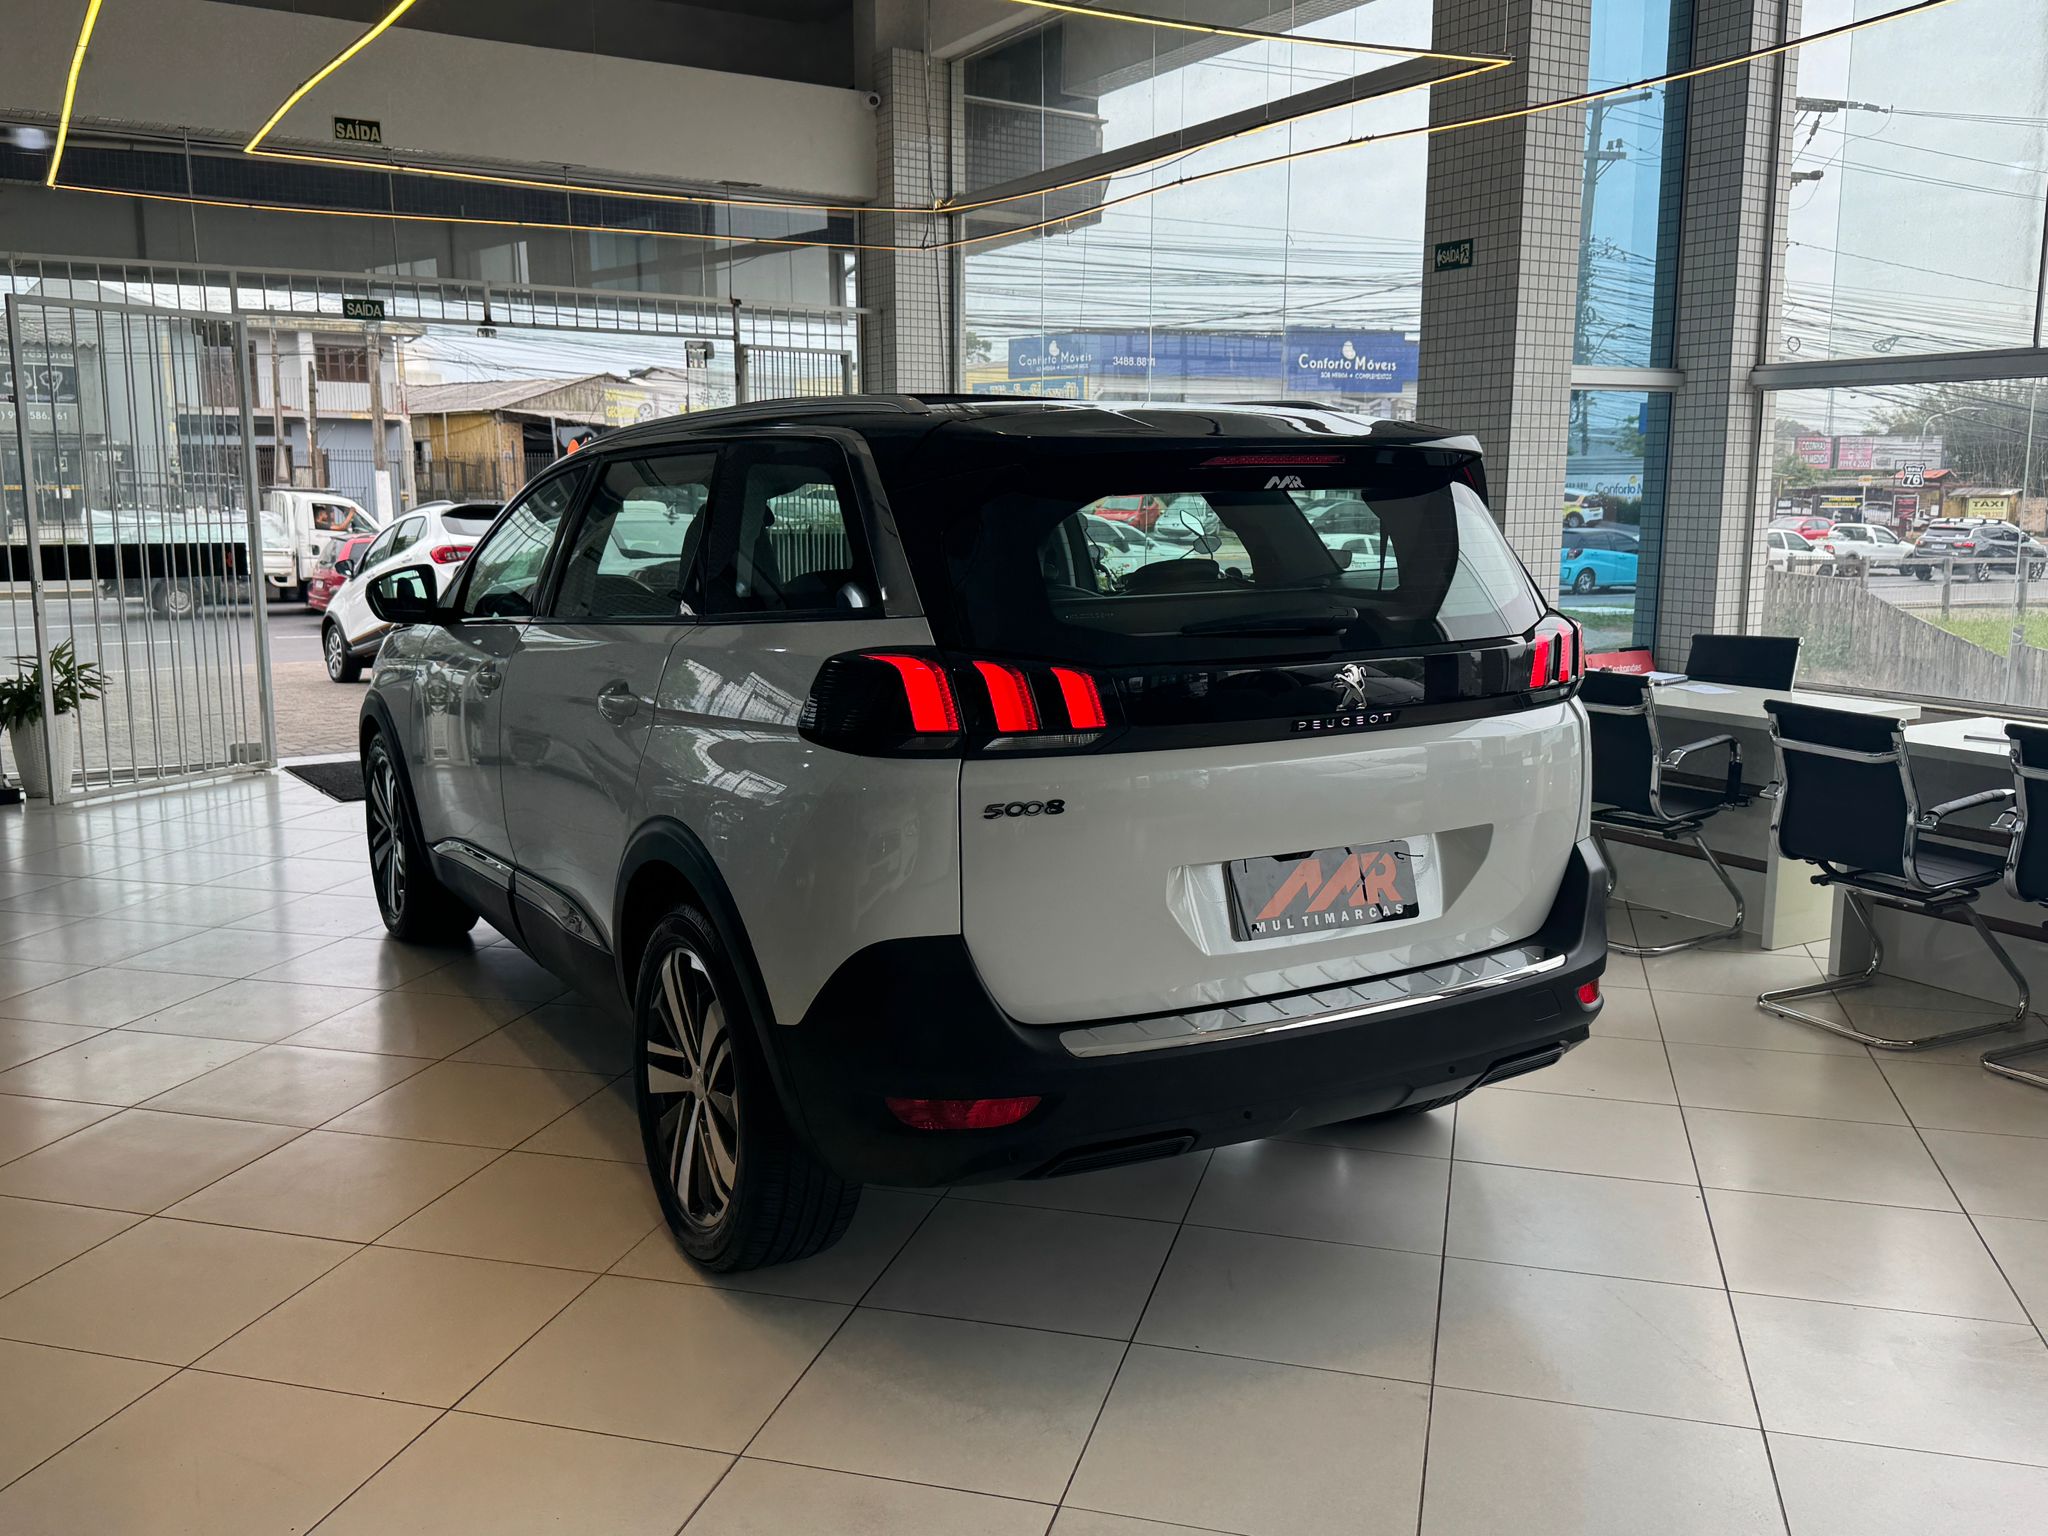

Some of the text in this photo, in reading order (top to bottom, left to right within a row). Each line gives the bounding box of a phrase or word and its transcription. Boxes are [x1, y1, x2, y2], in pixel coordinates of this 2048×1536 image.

[336, 120, 381, 142] SAÍDA
[346, 301, 383, 317] SAÍDA
[1298, 353, 1397, 371] Conforto Móveis
[1906, 474, 1920, 485] 76
[1297, 713, 1392, 730] PEUGEOT
[983, 799, 1065, 819] 5008
[1254, 903, 1404, 934] MULTIMARCAS
